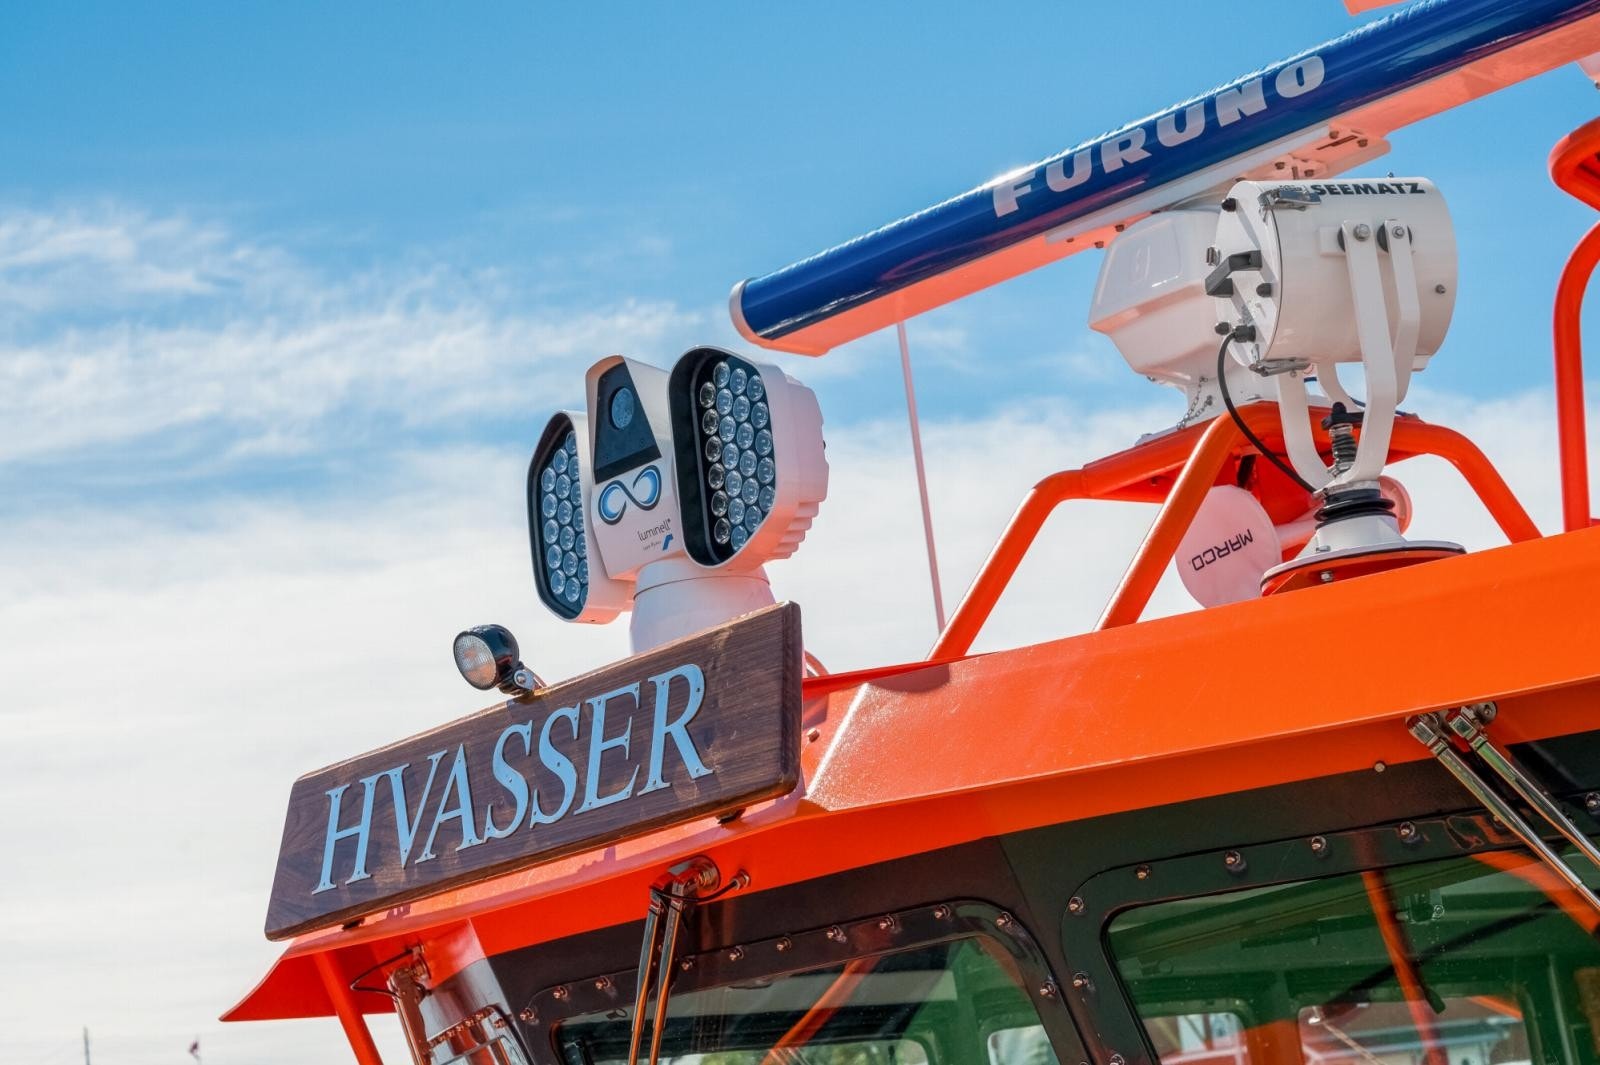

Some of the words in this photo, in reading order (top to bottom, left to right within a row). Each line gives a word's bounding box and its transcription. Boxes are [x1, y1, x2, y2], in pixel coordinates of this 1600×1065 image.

[993, 55, 1326, 218] FURUNO
[1310, 183, 1426, 196] SEEMATZ
[1191, 529, 1254, 571] MARCO
[312, 663, 714, 895] HVASSER
